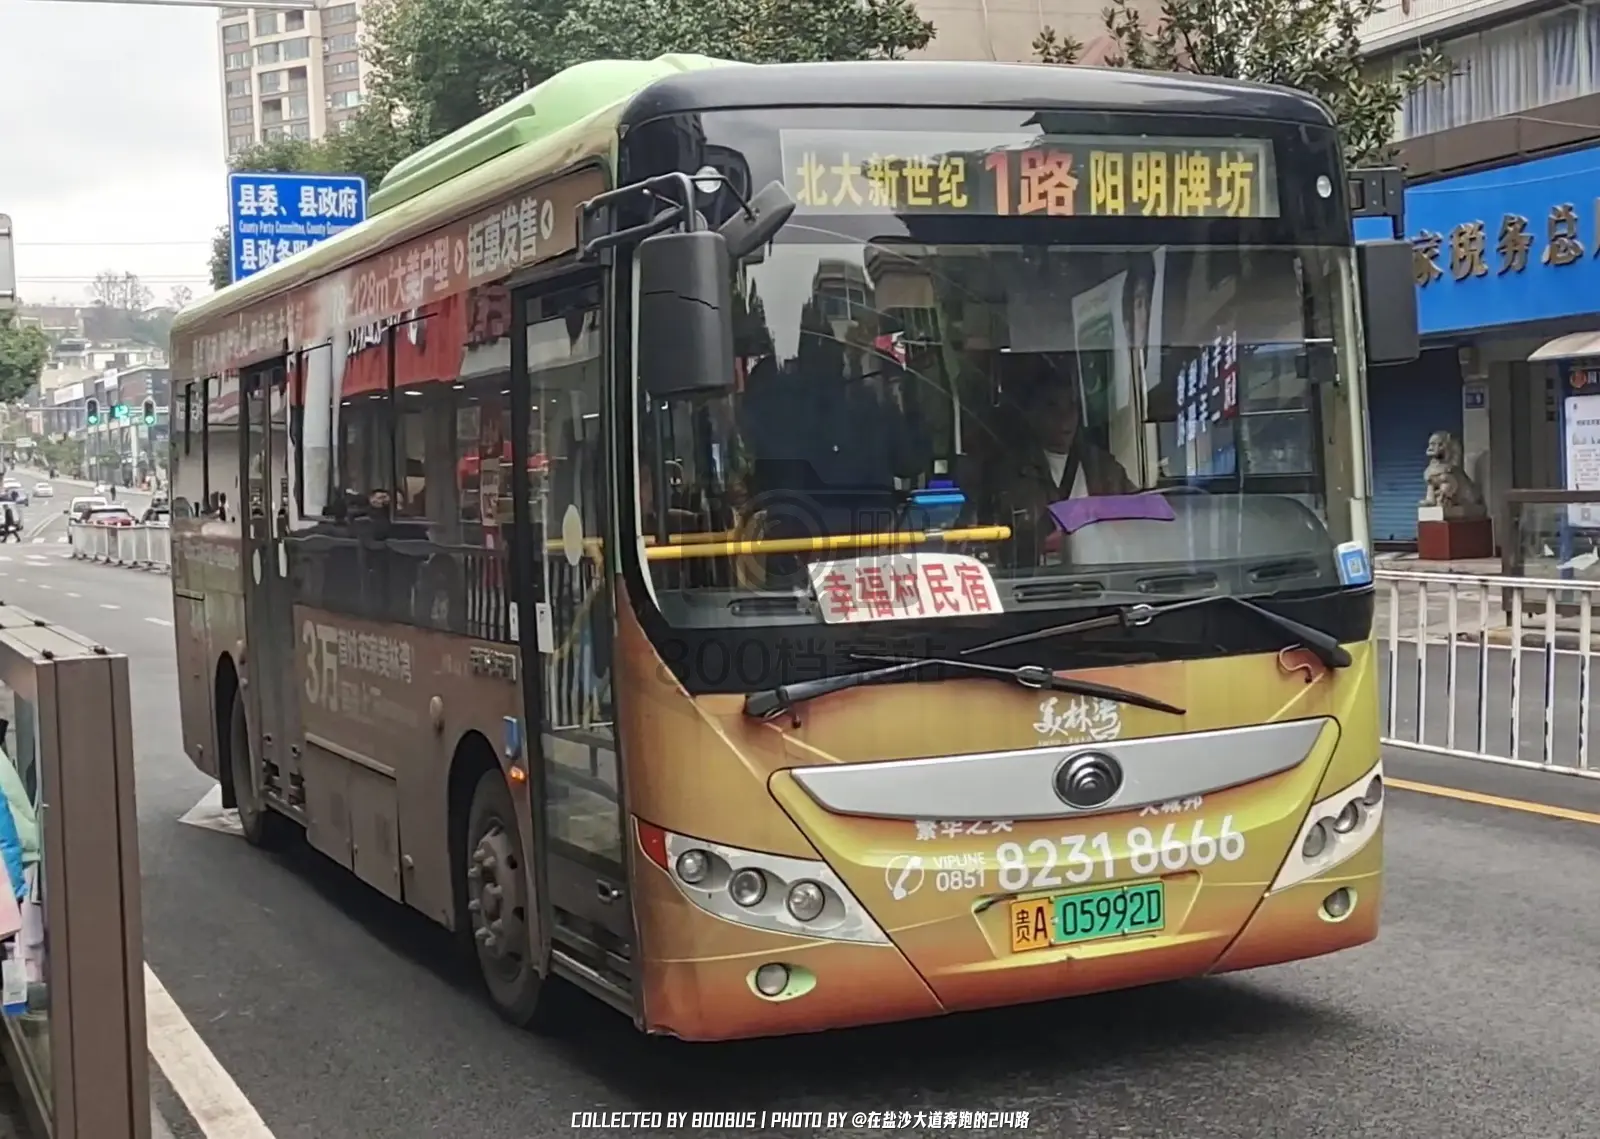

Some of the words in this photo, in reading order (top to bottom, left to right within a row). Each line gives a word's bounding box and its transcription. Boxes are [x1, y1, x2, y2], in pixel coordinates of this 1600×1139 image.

[238, 184, 358, 218] 县委、县政府
[795, 151, 969, 209] 北大新世纪
[984, 151, 1080, 217] 1路
[1089, 149, 1254, 218] 阳明牌坊
[1411, 197, 1600, 288] 家税务总
[823, 562, 993, 621] 幸福村民宿
[1033, 694, 1122, 741] 美林湾
[935, 867, 985, 892] 0851
